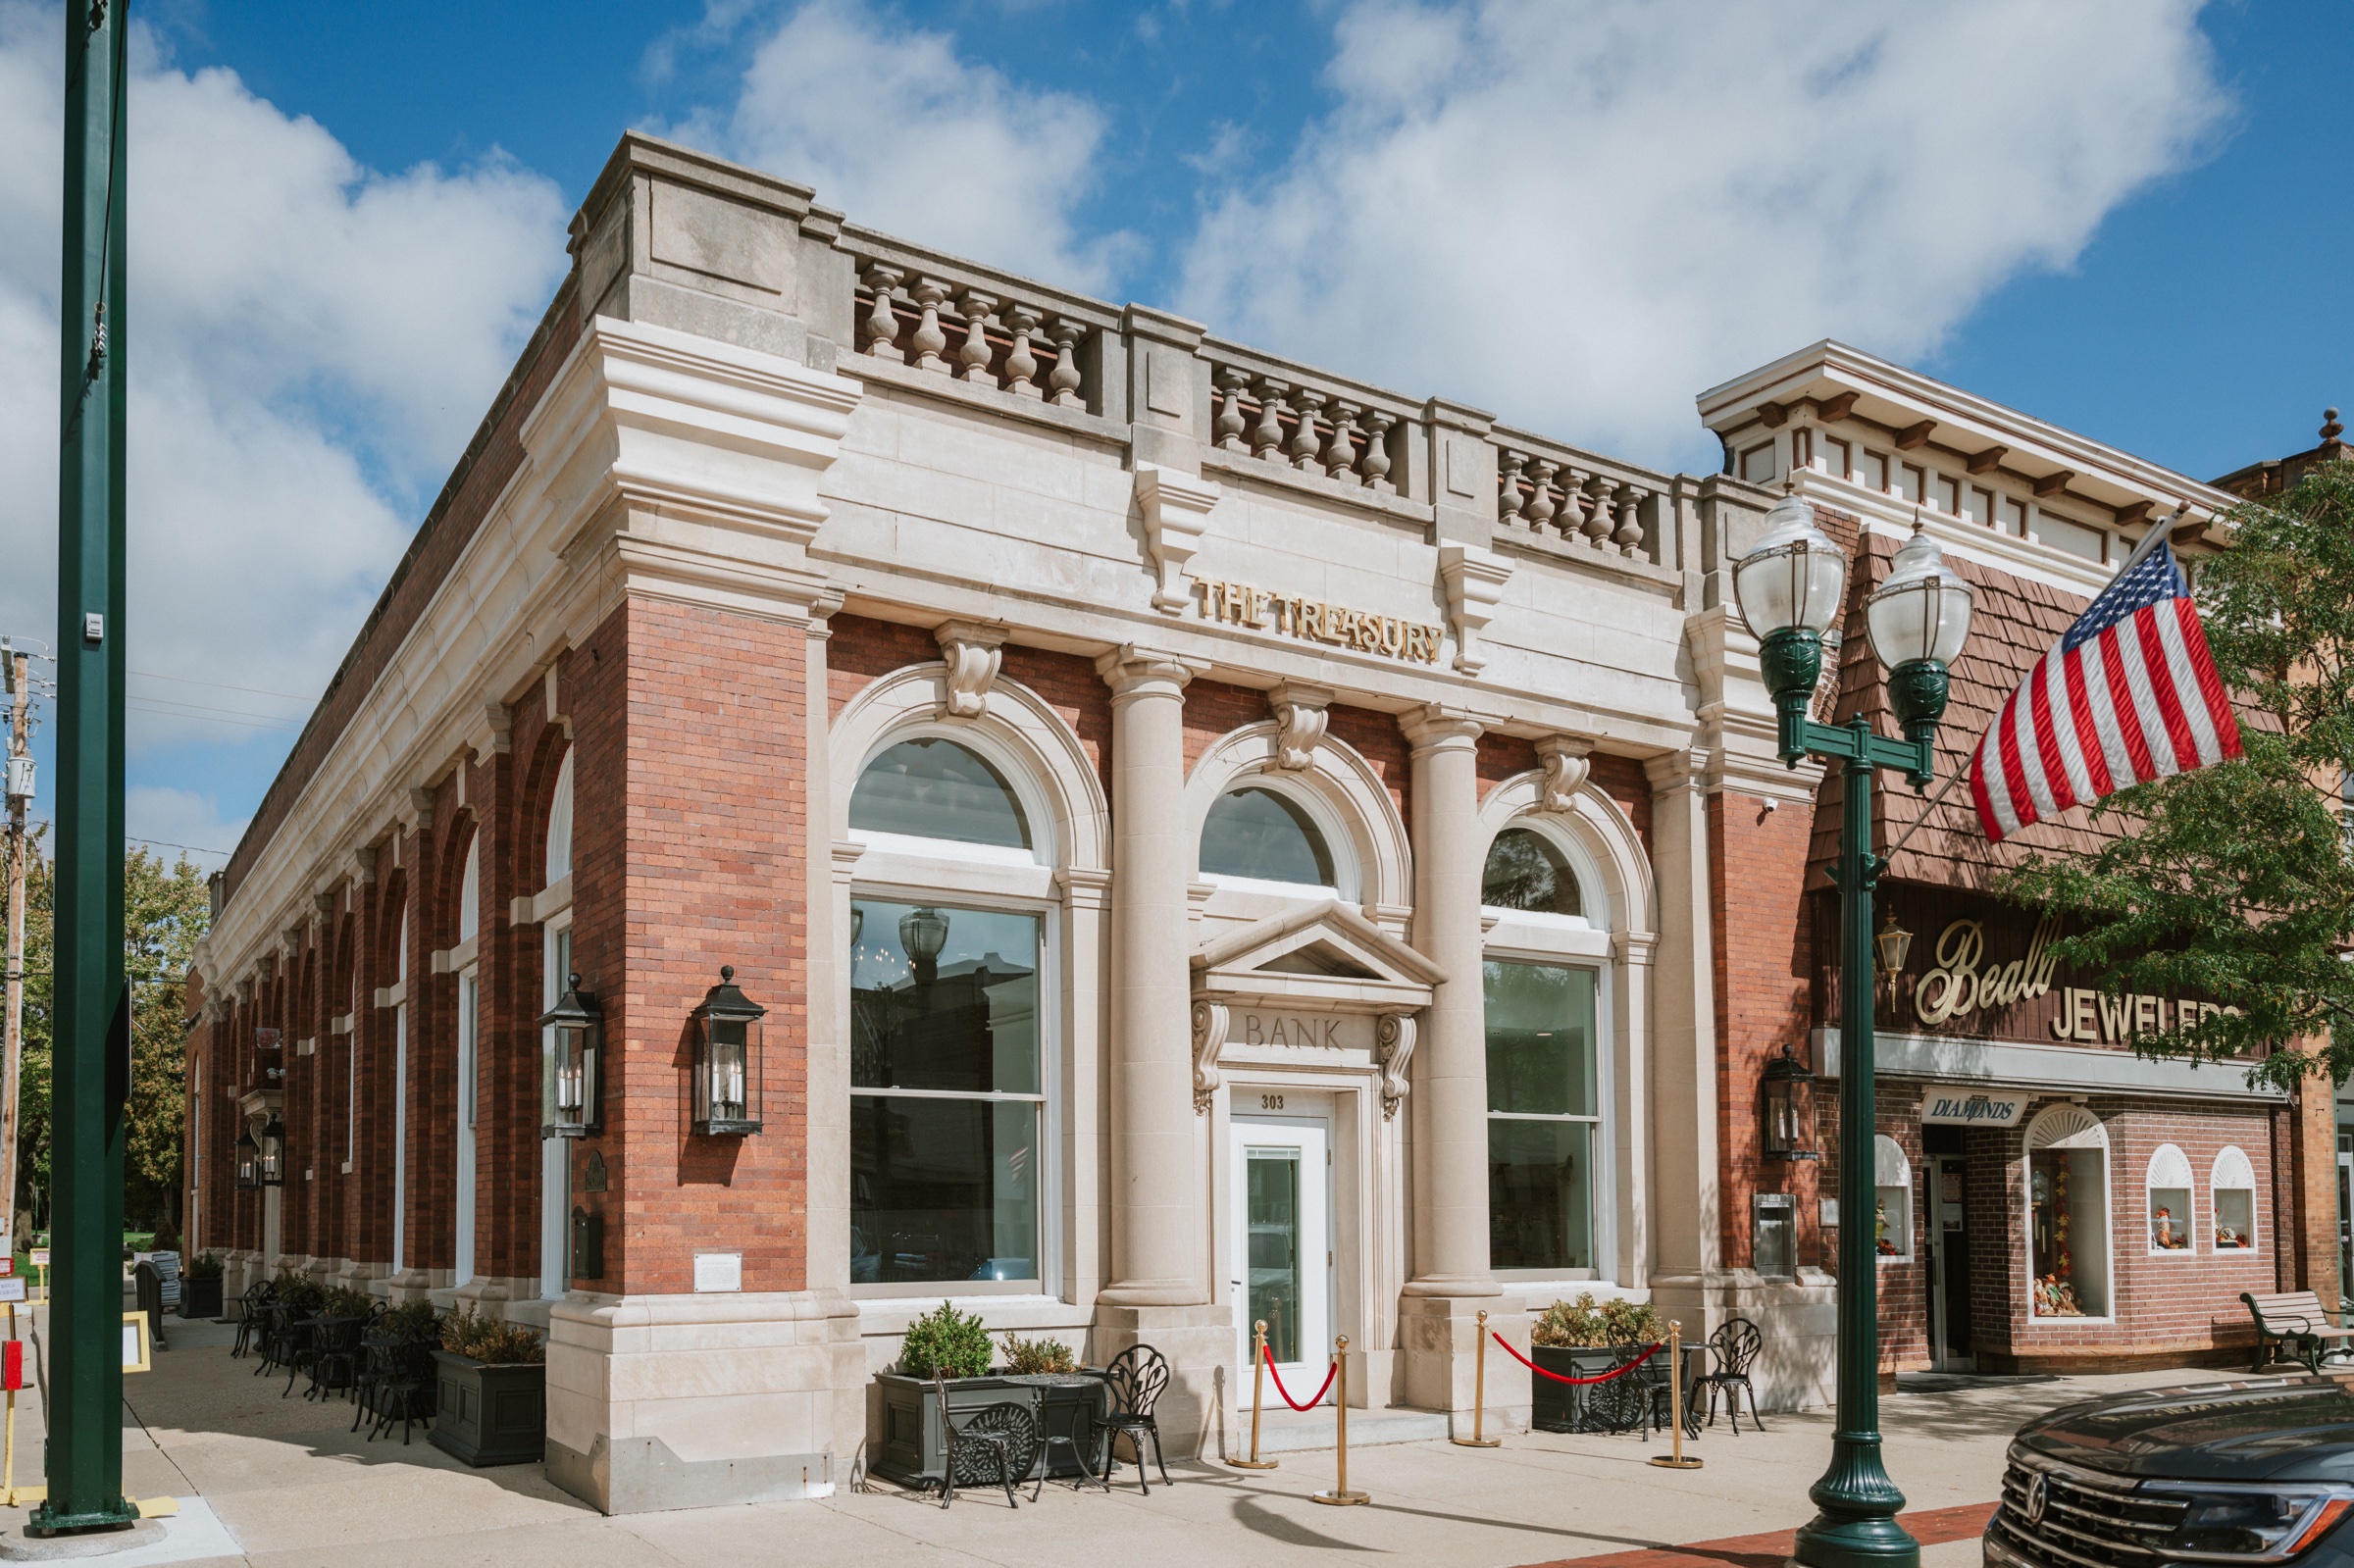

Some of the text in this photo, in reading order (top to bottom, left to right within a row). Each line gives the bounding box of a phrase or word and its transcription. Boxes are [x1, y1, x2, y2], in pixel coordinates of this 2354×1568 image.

[1194, 577, 1447, 663] THE TREASURY
[1245, 1014, 1345, 1051] BANK
[1261, 1094, 1284, 1110] 303
[1930, 1098, 2015, 1120] DIAMONDS
